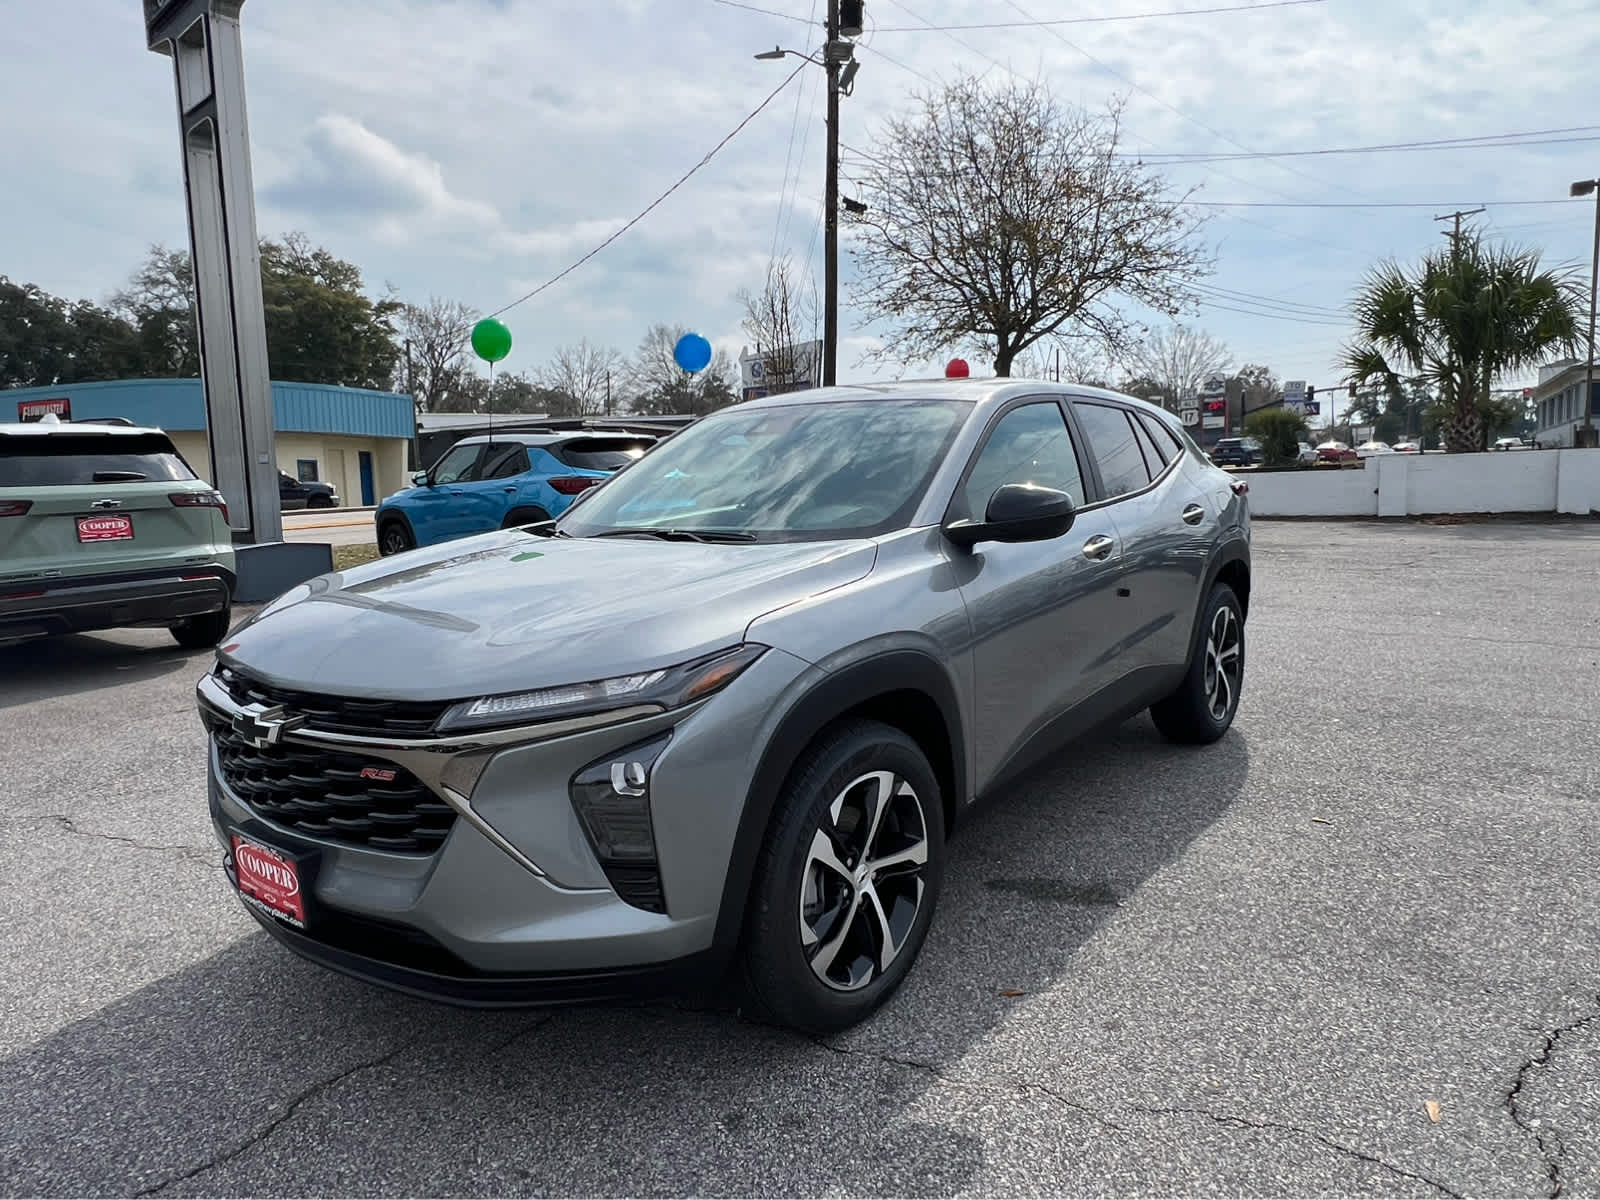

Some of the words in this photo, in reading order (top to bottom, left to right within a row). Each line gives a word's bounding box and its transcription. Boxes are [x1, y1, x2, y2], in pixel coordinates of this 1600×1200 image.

[1184, 412, 1194, 423] 17
[82, 520, 125, 530] COOPER
[360, 768, 396, 782] RS
[240, 850, 293, 889] COOPER
